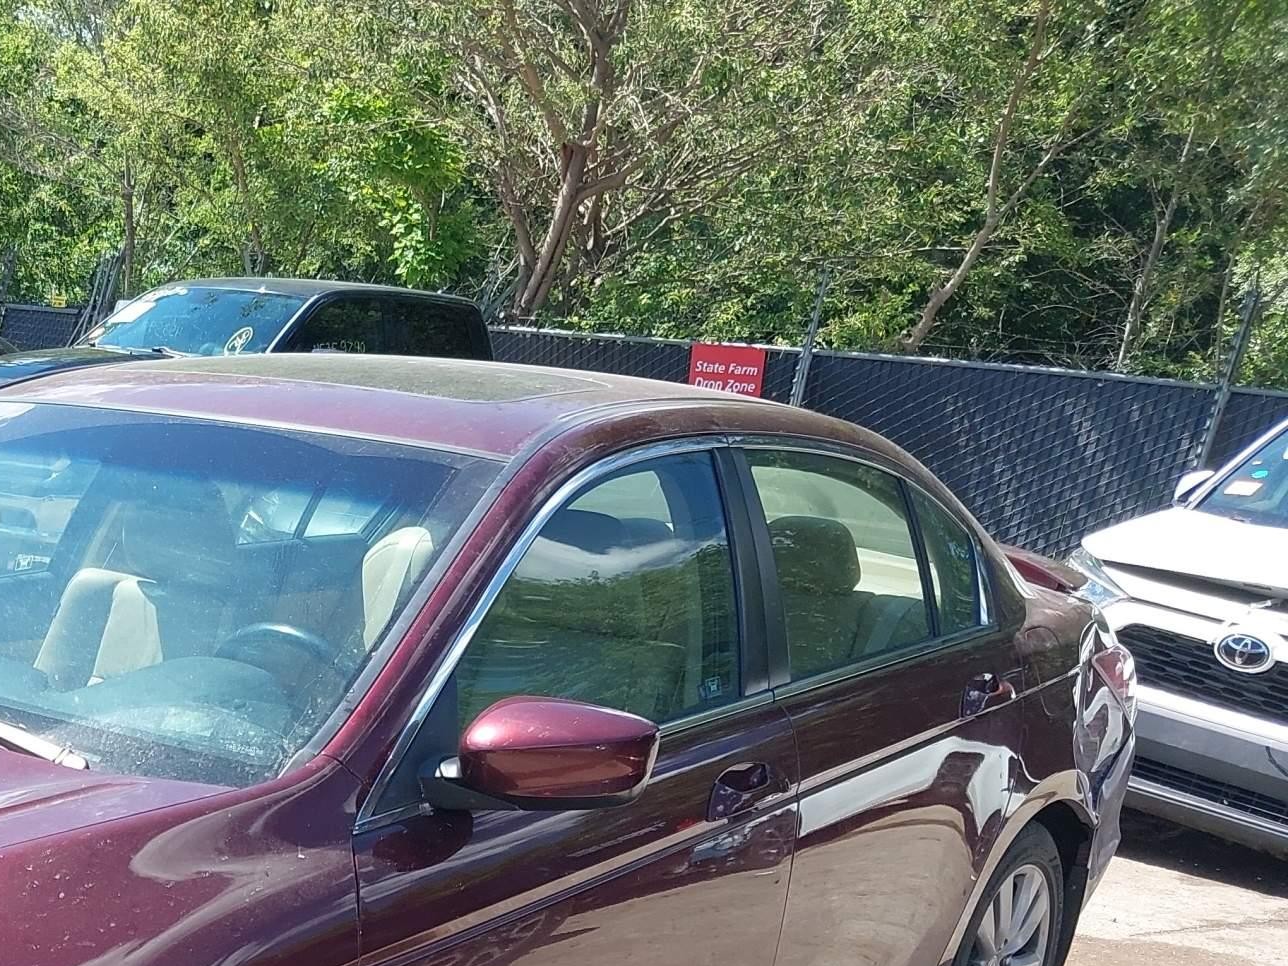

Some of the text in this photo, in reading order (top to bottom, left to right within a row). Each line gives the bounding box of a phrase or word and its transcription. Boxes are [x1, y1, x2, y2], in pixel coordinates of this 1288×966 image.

[695, 361, 758, 376] State Farm
[725, 380, 756, 393] Zone
